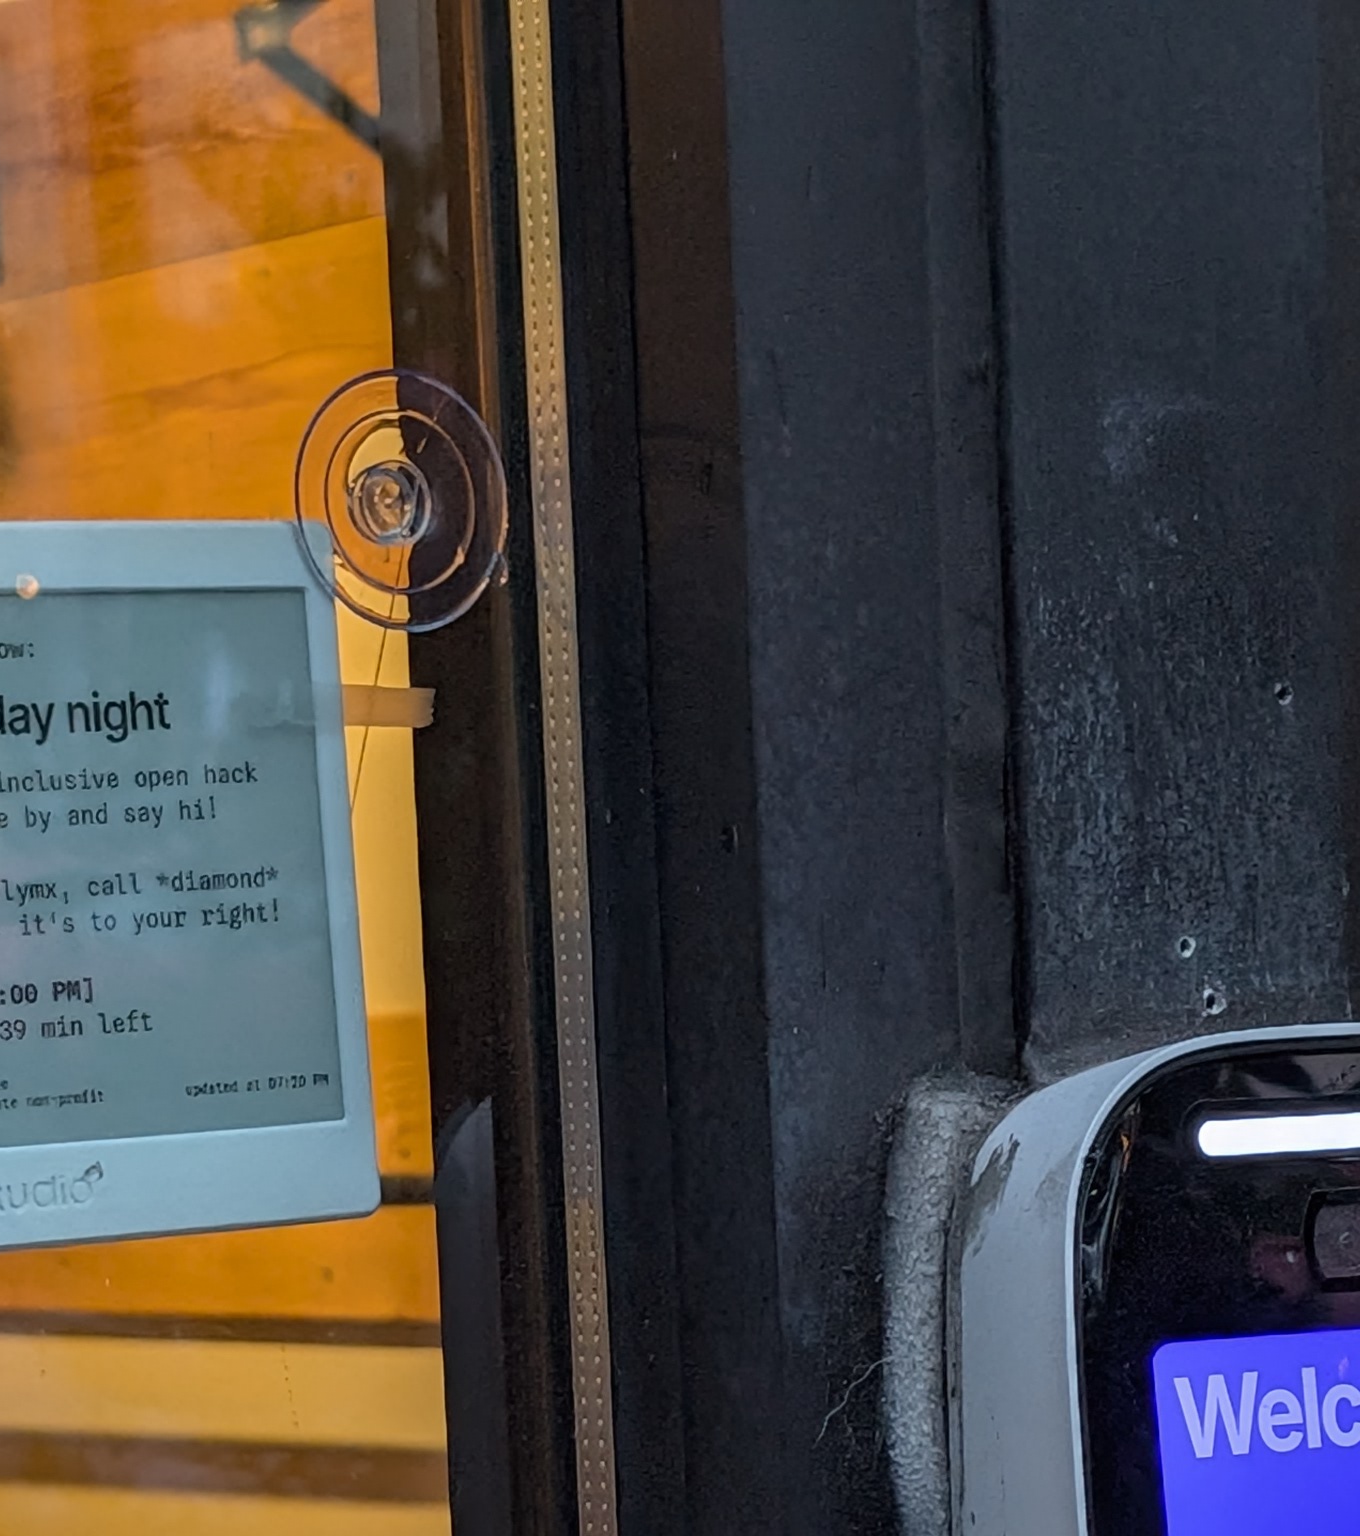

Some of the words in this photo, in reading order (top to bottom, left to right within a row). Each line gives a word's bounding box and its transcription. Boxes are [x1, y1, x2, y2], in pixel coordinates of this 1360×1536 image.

[67, 690, 171, 743] night
[135, 764, 189, 790] open
[204, 761, 258, 785] hack
[25, 805, 51, 833] by
[68, 802, 108, 826] and
[124, 805, 163, 828] say
[179, 796, 217, 820] hi!
[88, 873, 141, 897] call
[19, 913, 75, 936] it's
[91, 910, 116, 932] to
[134, 909, 187, 936] your
[202, 898, 280, 930] right!
[52, 977, 94, 1004] PM]
[0, 1018, 27, 1041] 39
[41, 1016, 84, 1039] min
[98, 1009, 153, 1035] left
